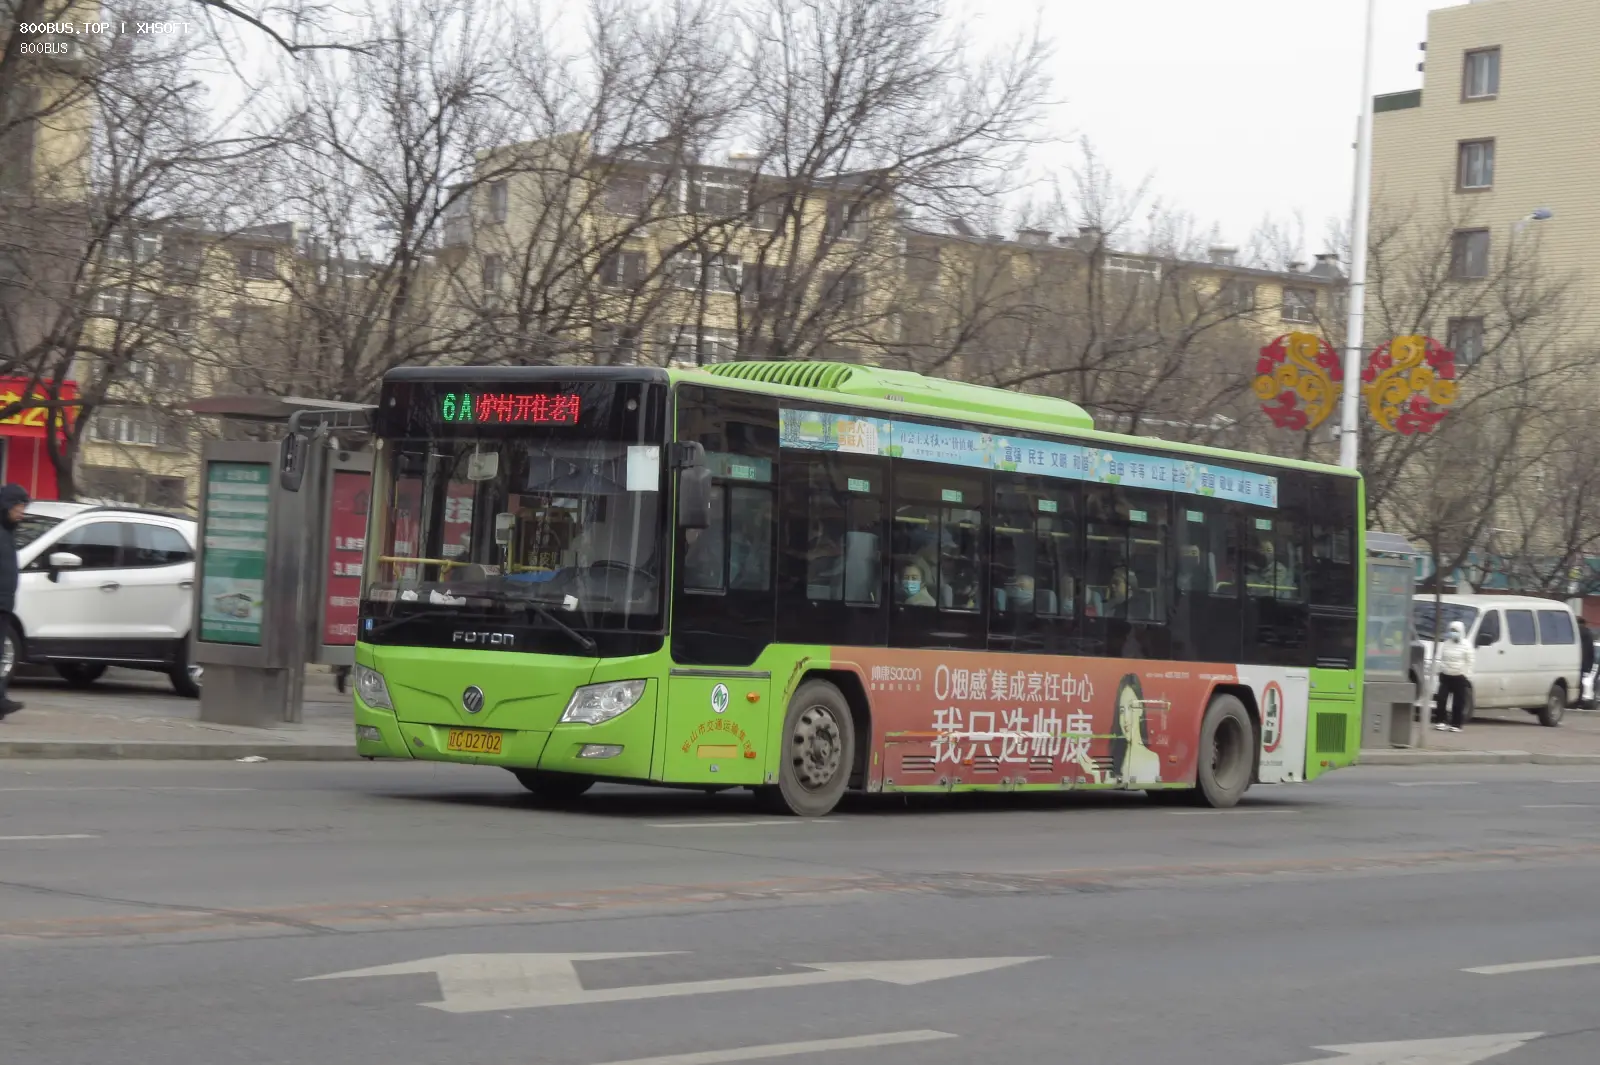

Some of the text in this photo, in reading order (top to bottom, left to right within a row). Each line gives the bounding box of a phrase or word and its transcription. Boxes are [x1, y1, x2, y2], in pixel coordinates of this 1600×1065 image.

[1004, 446, 1021, 463] 富强
[1028, 449, 1045, 466] 民主
[1051, 452, 1067, 468] 文明
[1109, 460, 1125, 476] 自由
[452, 631, 515, 646] FOTON
[930, 706, 1094, 764] 我只选帅康
